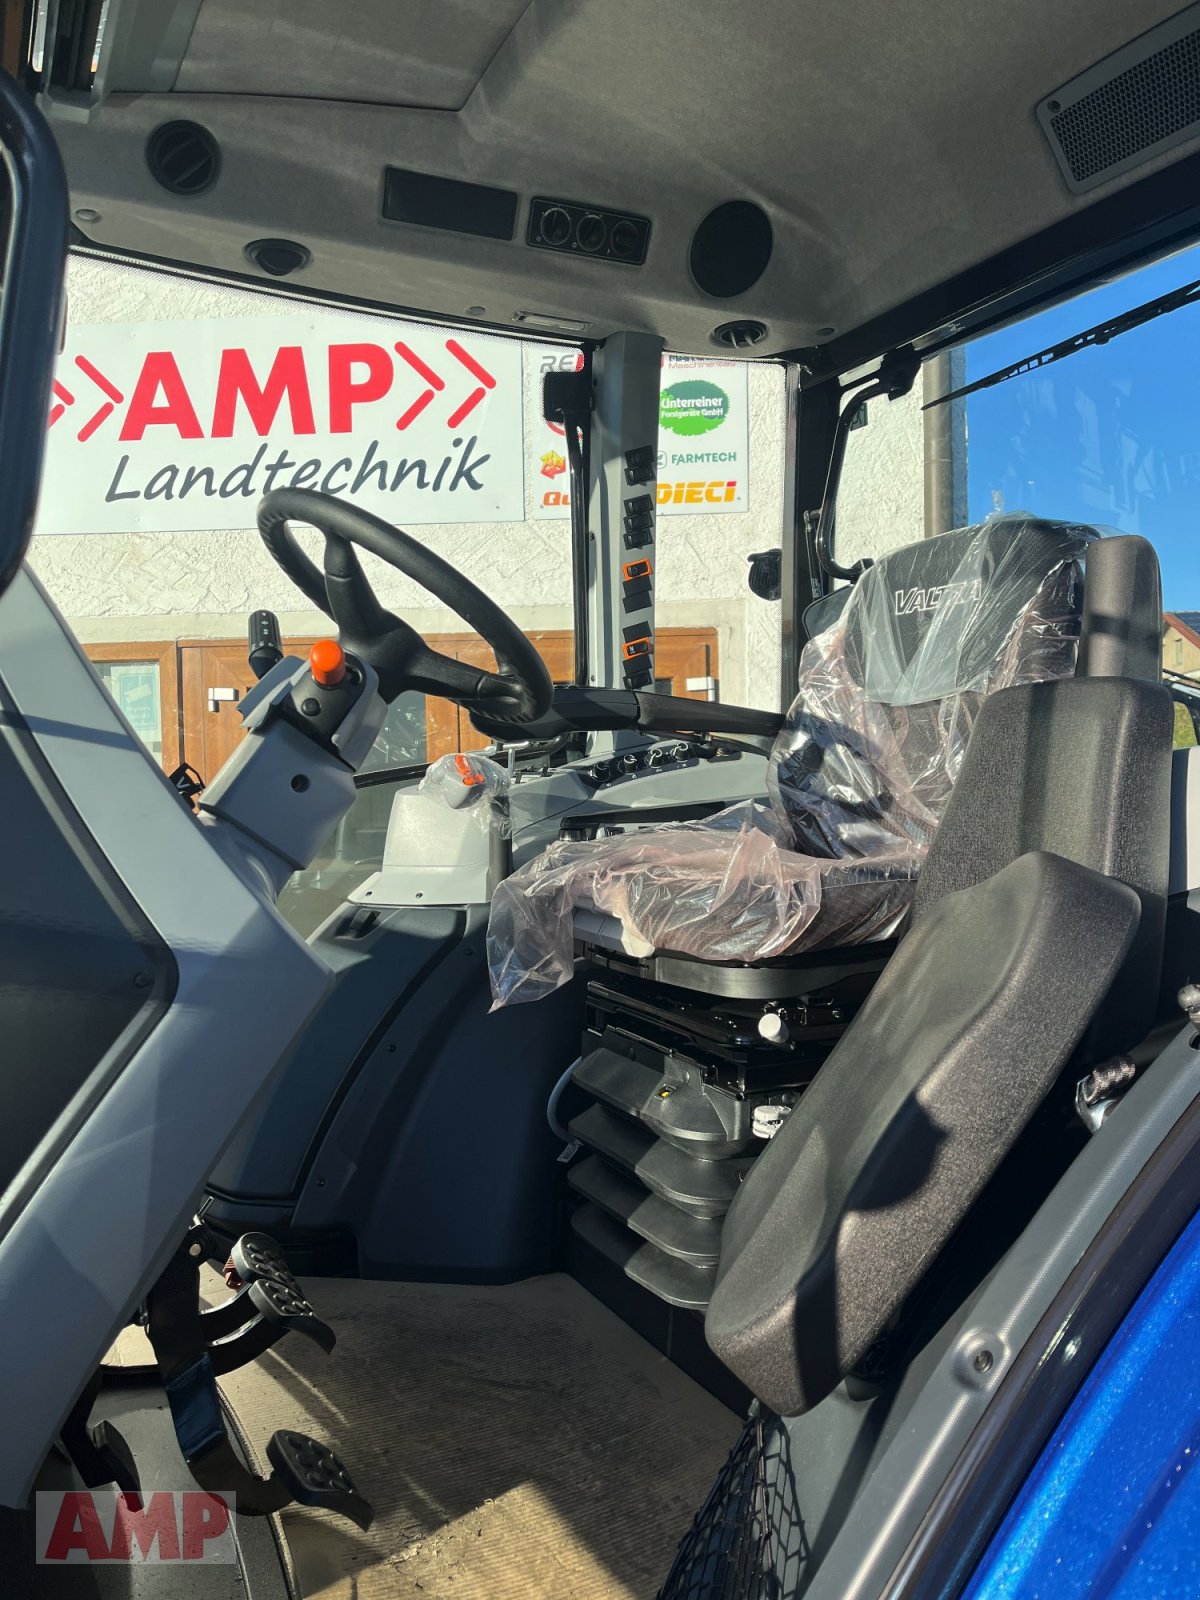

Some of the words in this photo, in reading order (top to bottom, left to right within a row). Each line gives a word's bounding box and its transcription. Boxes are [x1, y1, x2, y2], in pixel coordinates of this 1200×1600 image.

[119, 342, 395, 441] AMP
[660, 396, 723, 409] Unterreiner
[701, 408, 724, 417] GmbH
[671, 452, 737, 466] FARMTECH
[105, 435, 492, 503] Landtechnik
